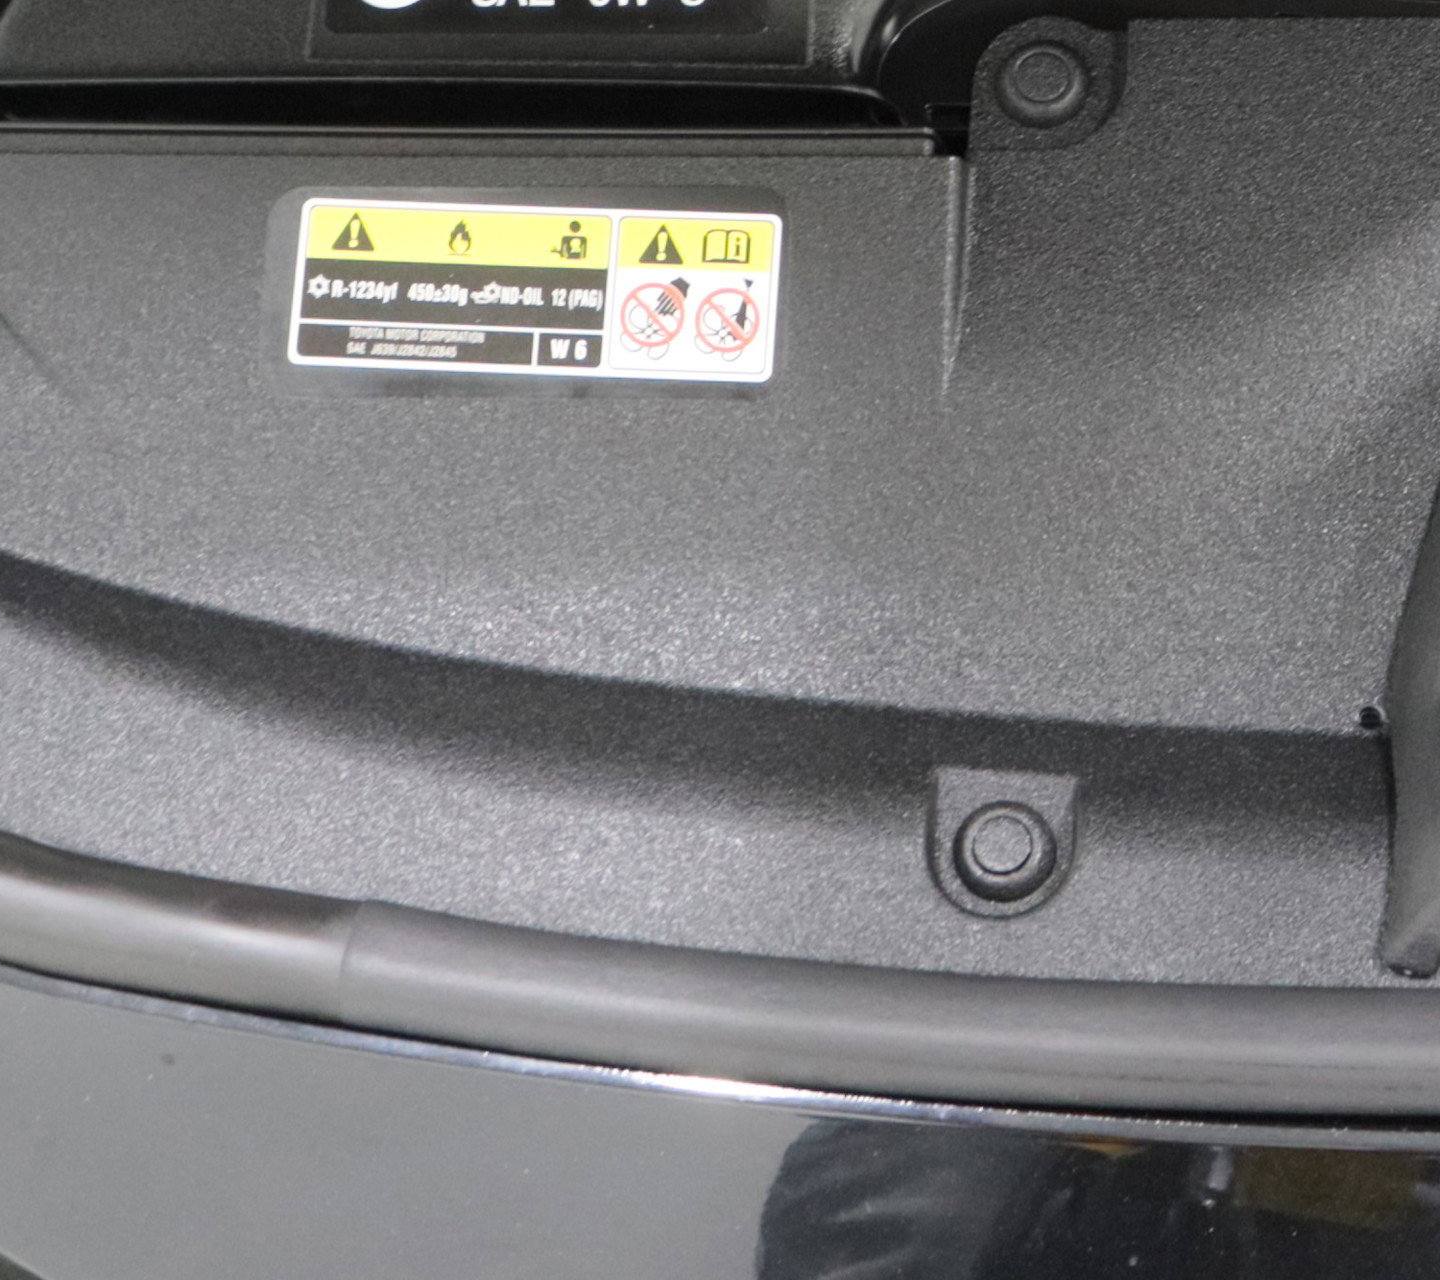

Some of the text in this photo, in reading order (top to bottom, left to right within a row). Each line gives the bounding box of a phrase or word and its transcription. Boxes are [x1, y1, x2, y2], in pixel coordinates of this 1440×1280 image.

[551, 288, 566, 306] 12
[568, 288, 603, 312] (PAG)
[550, 338, 587, 361] W 6
